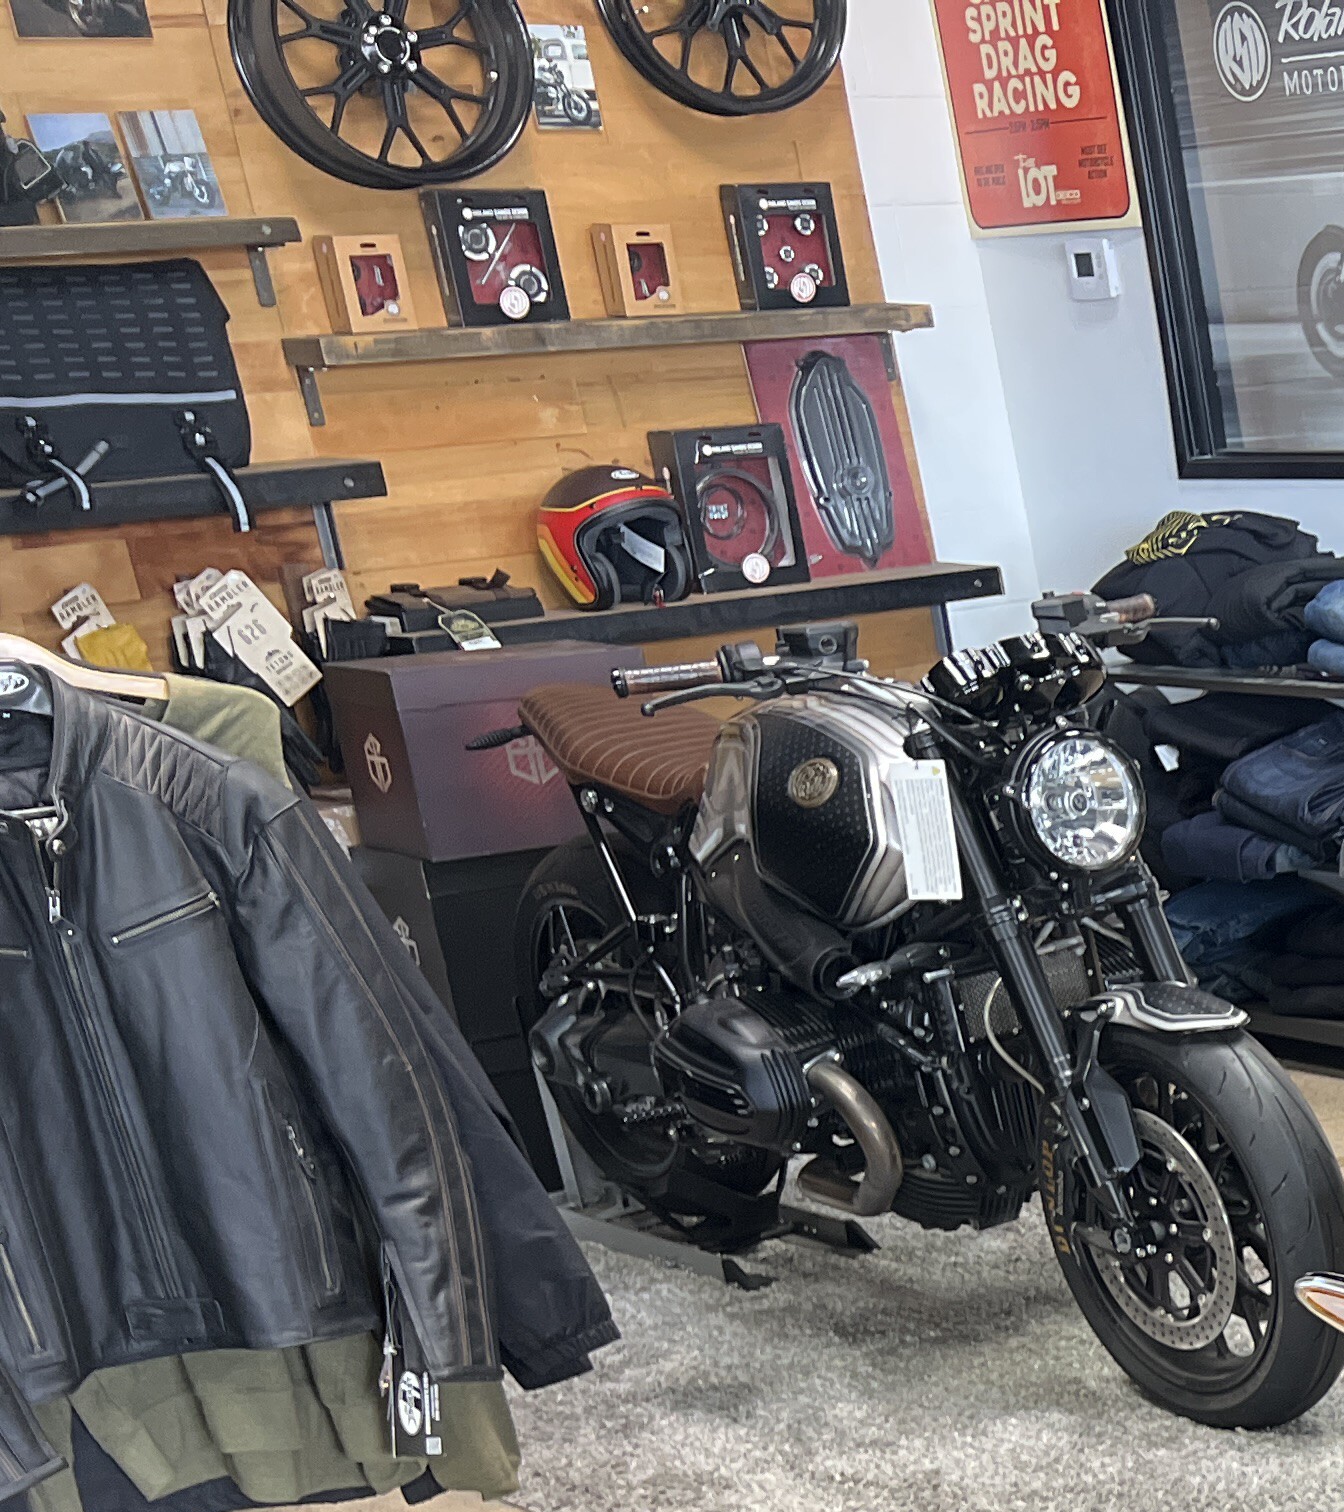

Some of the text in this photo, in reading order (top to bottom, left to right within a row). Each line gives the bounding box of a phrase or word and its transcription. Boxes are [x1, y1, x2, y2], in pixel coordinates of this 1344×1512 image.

[965, 0, 1060, 43] SPRINT
[979, 34, 1057, 80] DRAG
[972, 70, 1081, 119] RACING
[1017, 164, 1058, 208] LOT
